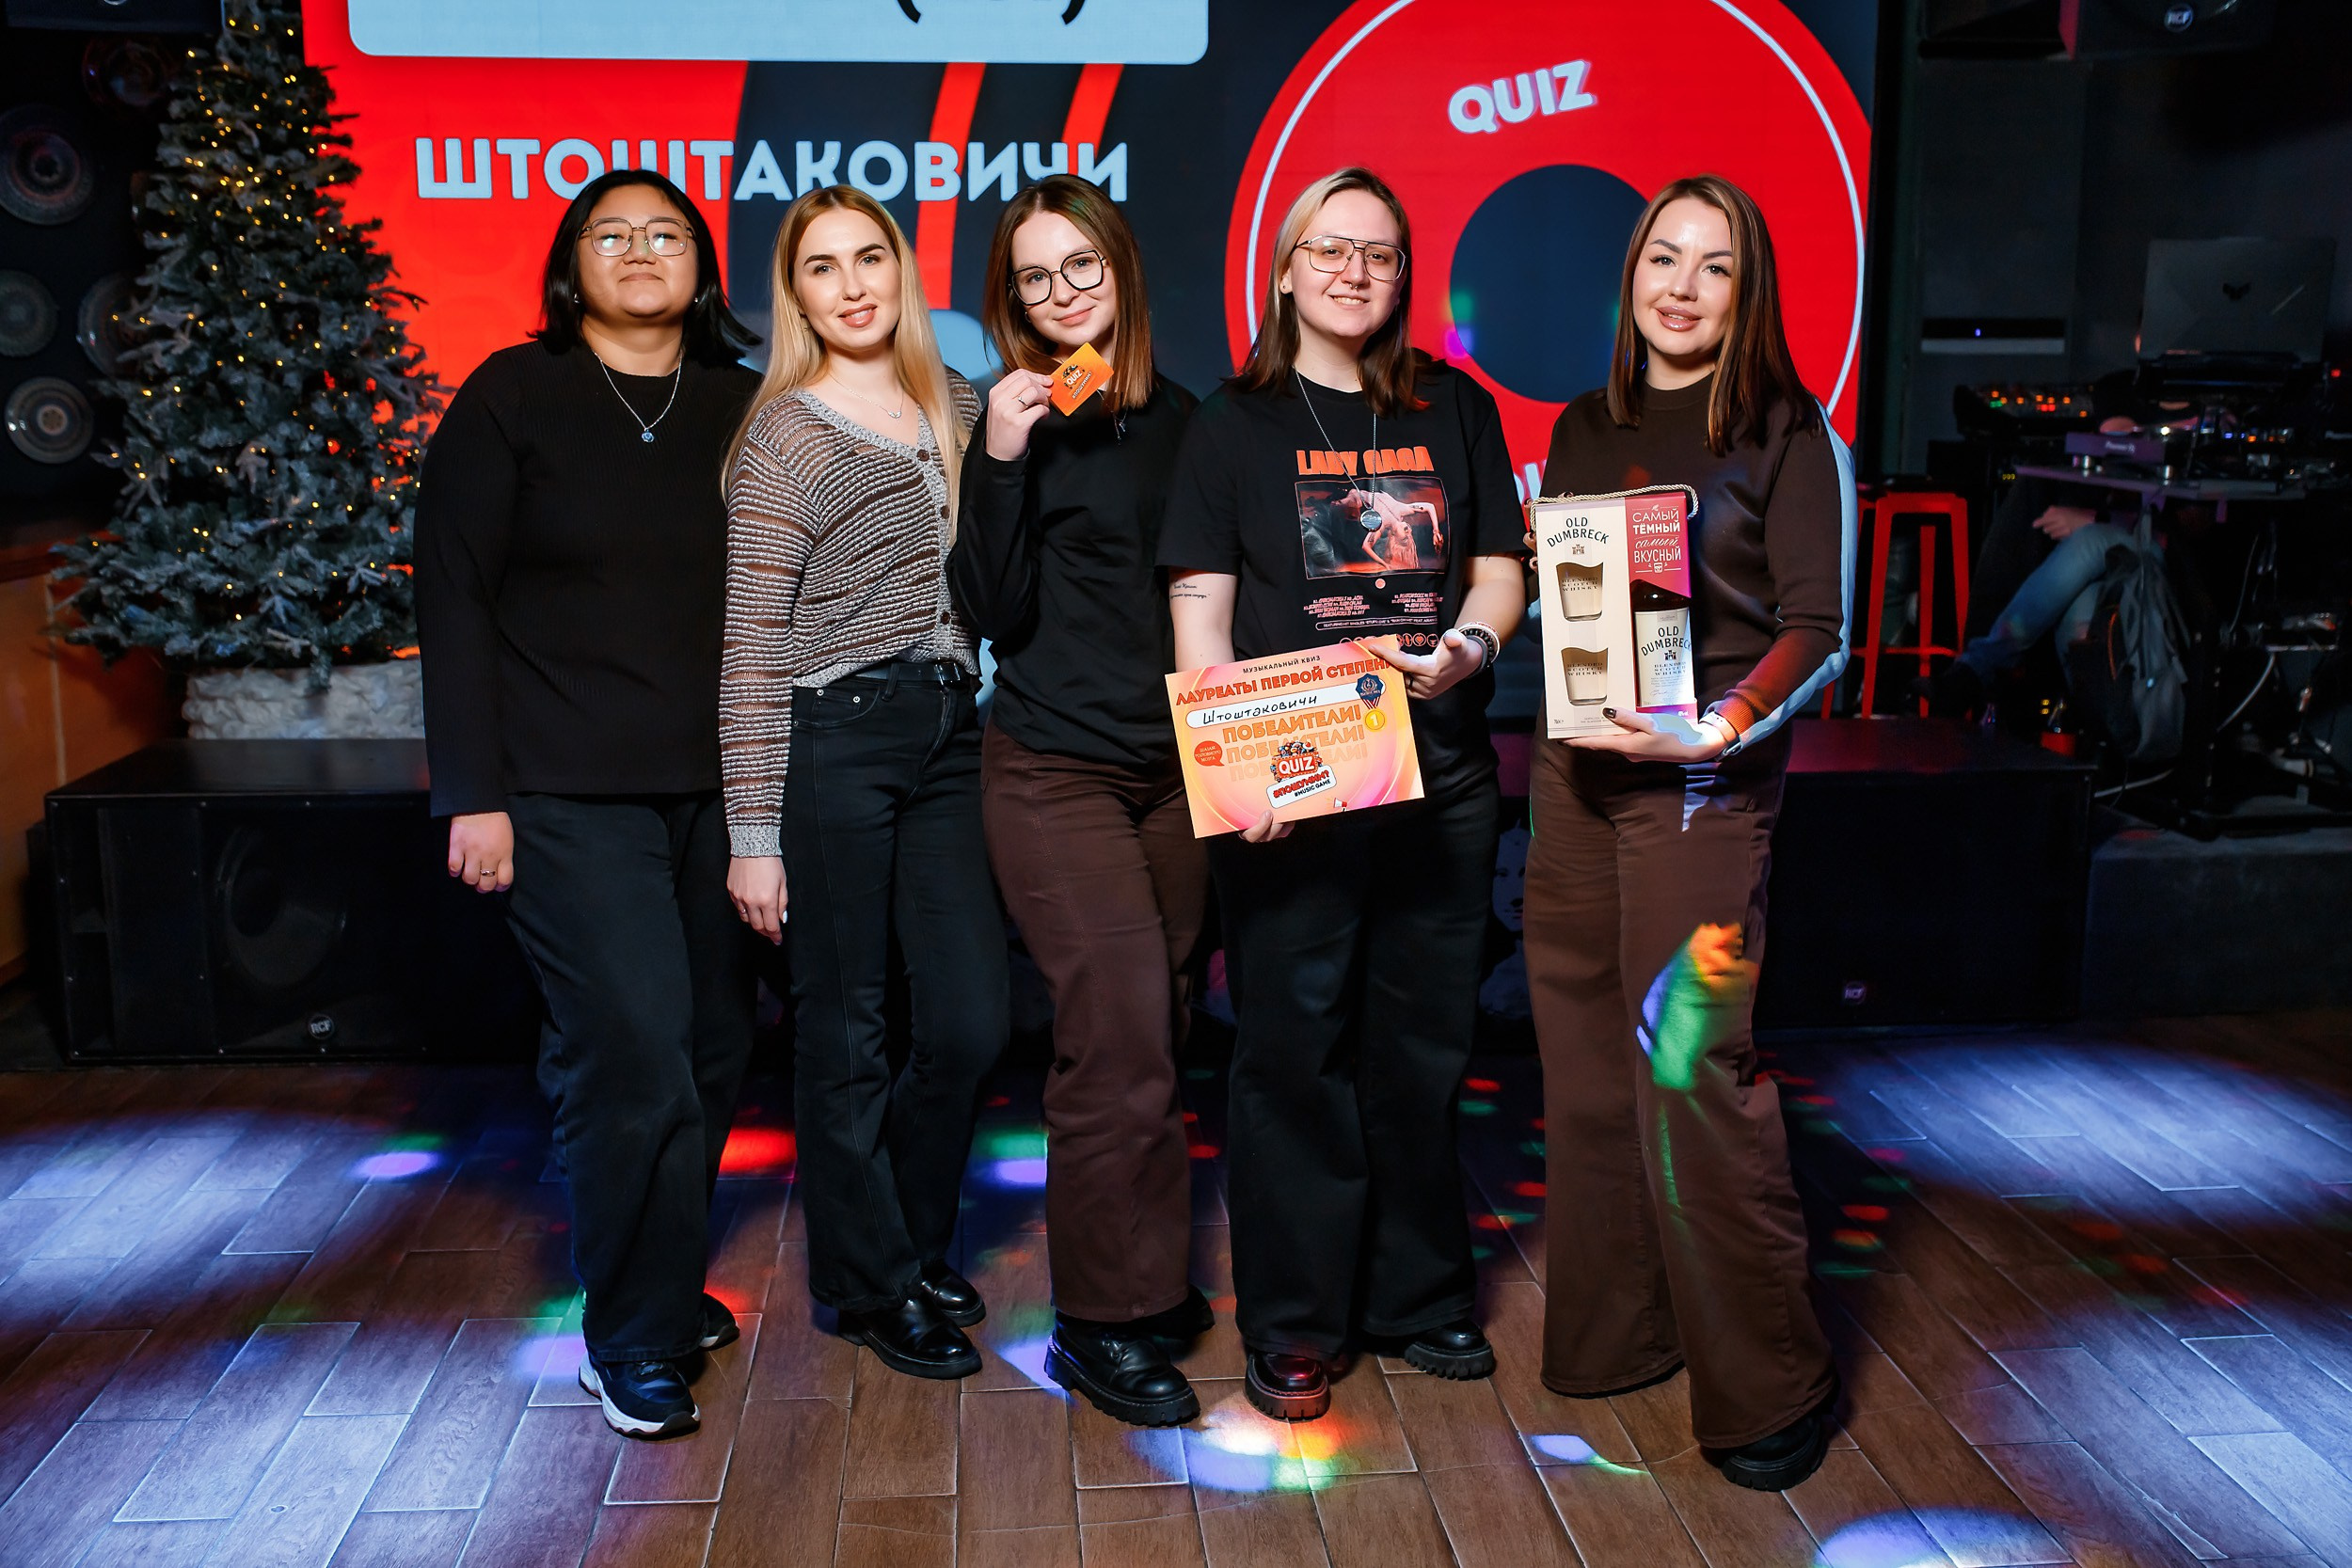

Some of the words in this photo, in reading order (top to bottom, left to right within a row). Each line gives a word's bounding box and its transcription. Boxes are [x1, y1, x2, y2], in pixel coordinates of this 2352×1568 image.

[1449, 59, 1596, 134] QUIZ
[416, 137, 1128, 201] ШТОШТАКОВИЧИ
[1066, 369, 1083, 386] QUIZ
[1296, 450, 1358, 476] LADY
[1363, 446, 1435, 475] GAGA
[1565, 516, 1588, 528] OLD
[1632, 508, 1679, 522] САМЫЙ
[1632, 520, 1680, 534] ТЁМНЫЙ
[1547, 529, 1609, 547] DUMBRECK
[1635, 537, 1679, 548] самый
[1633, 546, 1681, 563] ВКУСНЫЙ
[1658, 626, 1679, 638] OLD
[1243, 658, 1299, 673] МУЗЫКАЛЬНЫЙ
[1301, 655, 1321, 664] КВИЗ
[1176, 680, 1258, 706] ЛАУРЕАТЫ
[1261, 665, 1324, 690] ПЕРВОЙ
[1222, 705, 1361, 744] ПОБЕДИТЕЛИ!
[1370, 714, 1379, 726] 1
[1279, 756, 1314, 775] QUIZ
[1294, 784, 1315, 798] #MUSIC
[1315, 779, 1331, 789] GAME
[310, 1019, 331, 1034] RCF
